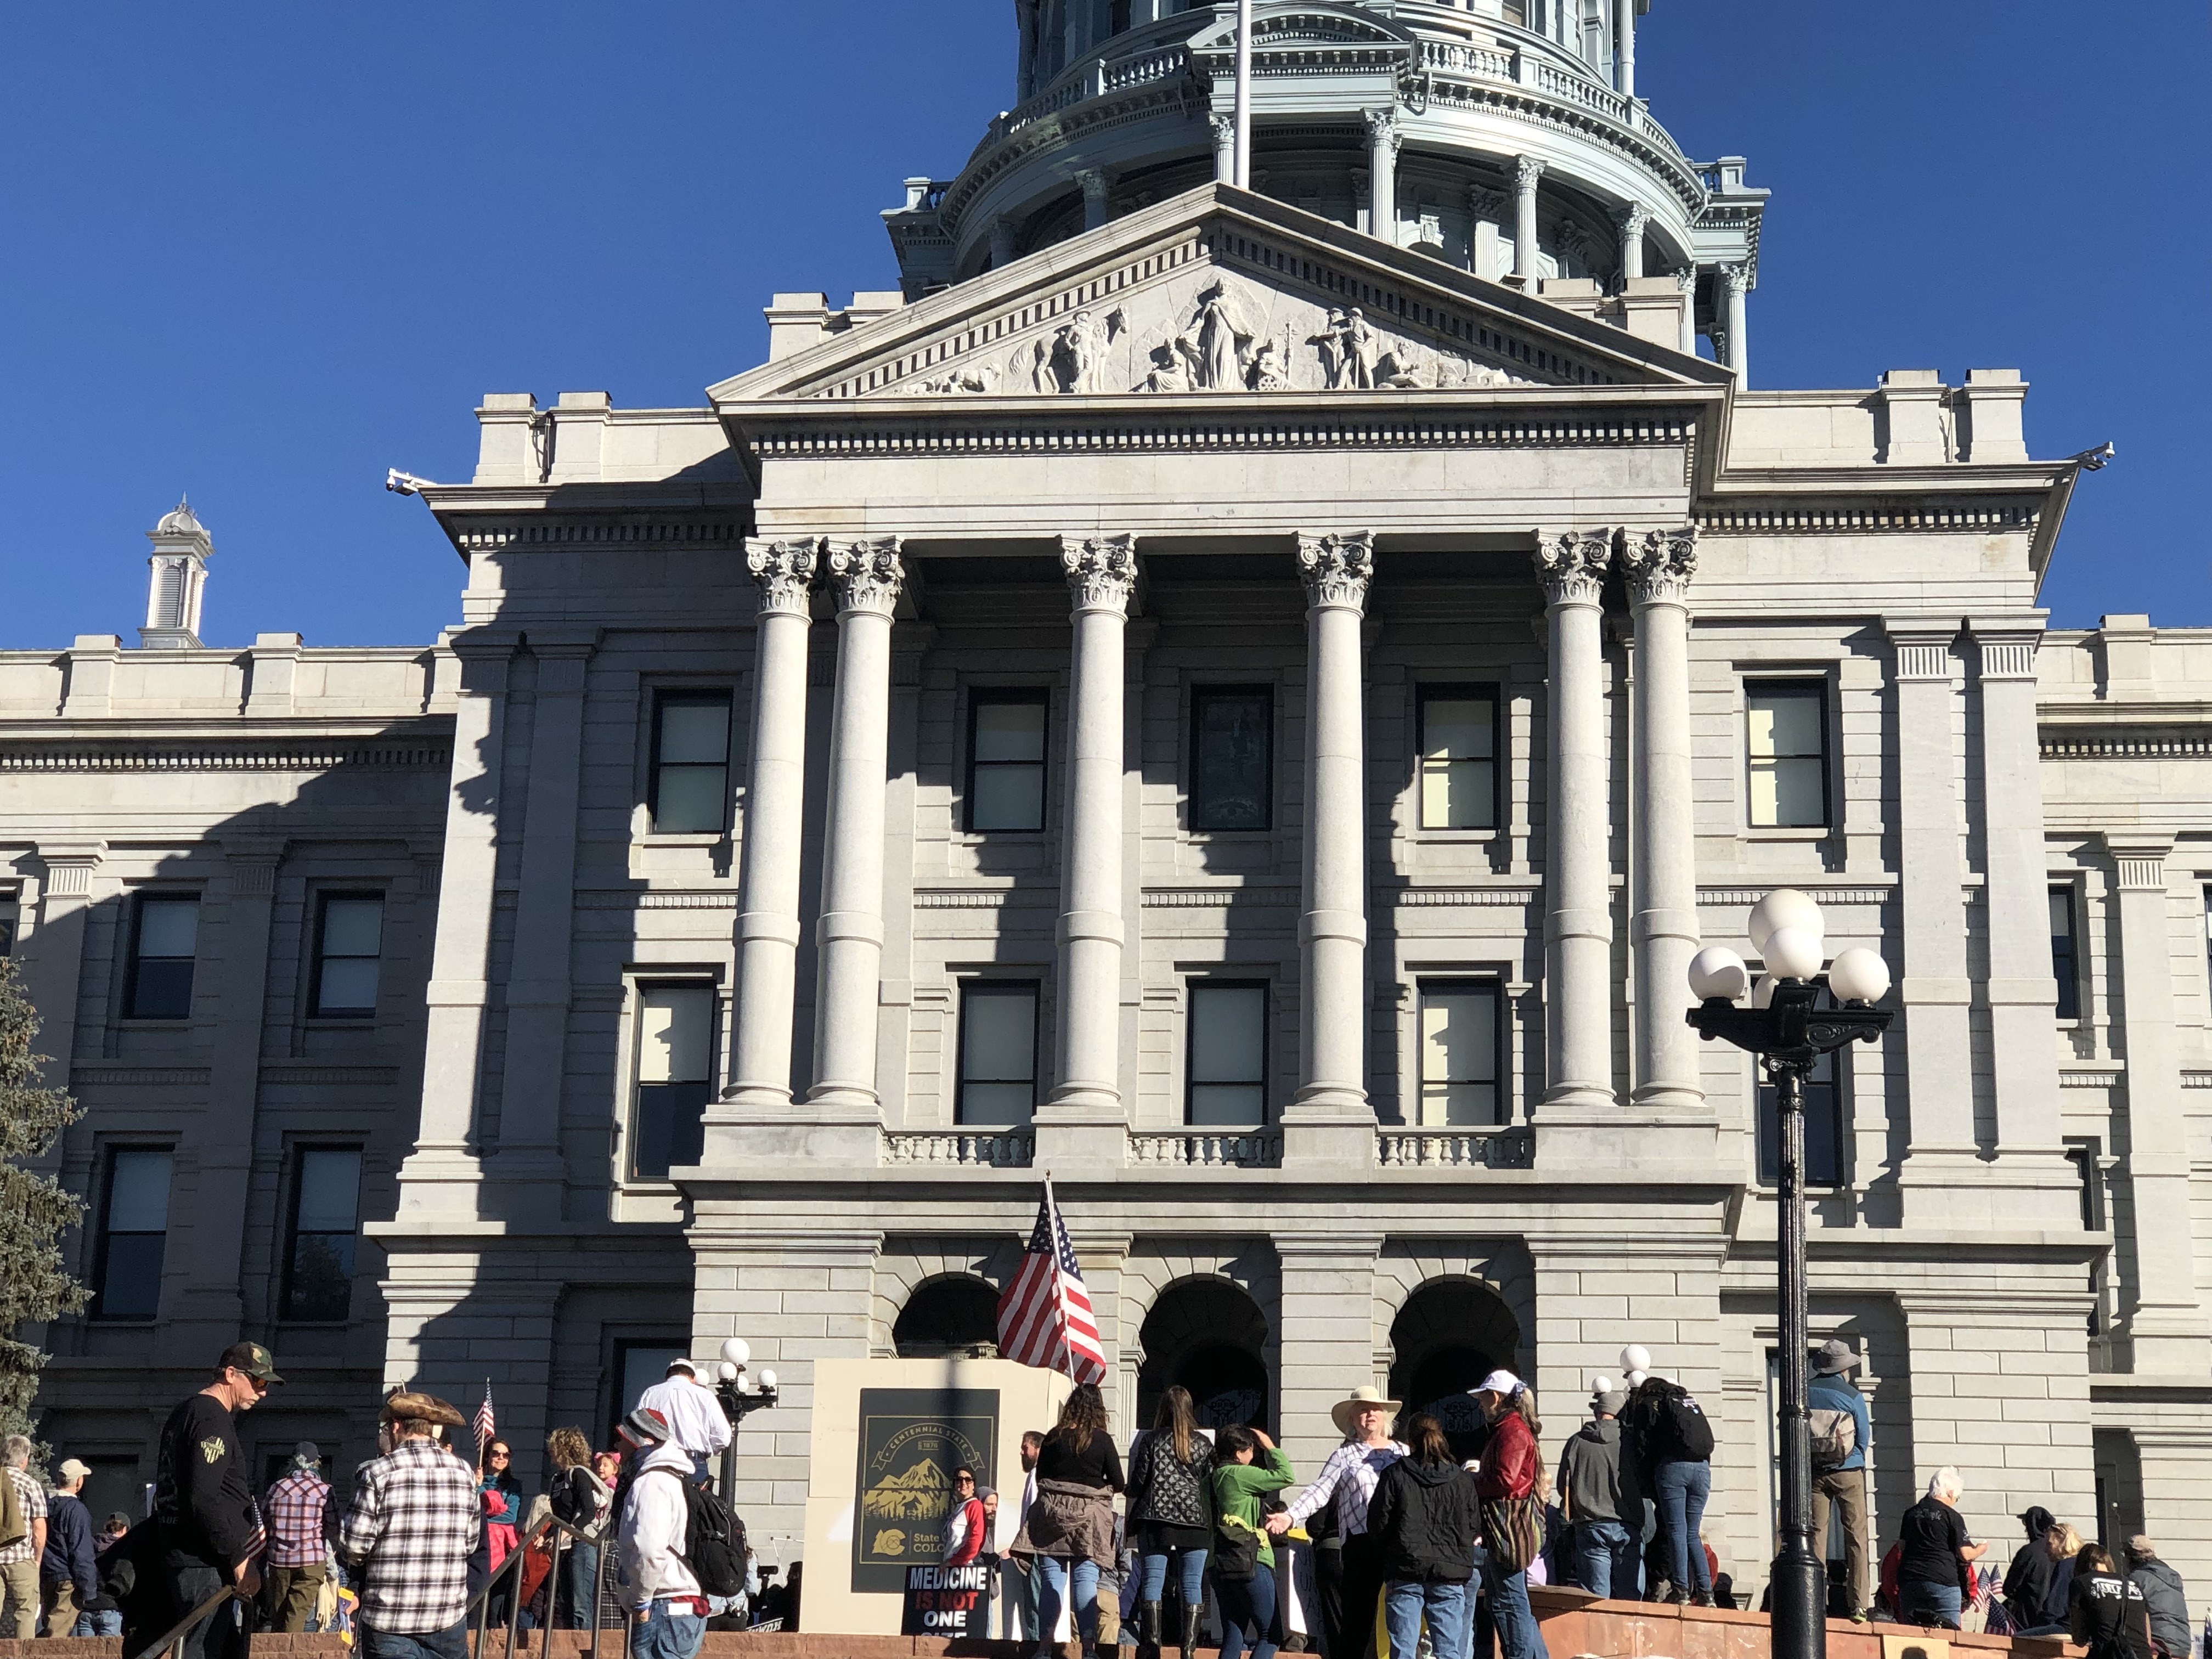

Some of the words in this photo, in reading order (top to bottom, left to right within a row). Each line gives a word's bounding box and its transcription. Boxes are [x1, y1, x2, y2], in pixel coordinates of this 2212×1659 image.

[889, 1426, 943, 1449] CENTENNIAL
[946, 1430, 969, 1450] STATE
[913, 1533, 940, 1542] State
[913, 1543, 945, 1553] COLO
[910, 1567, 987, 1590] MEDICINE
[915, 1592, 933, 1610] IS
[939, 1592, 979, 1610] NOT
[923, 1610, 967, 1627] ONE
